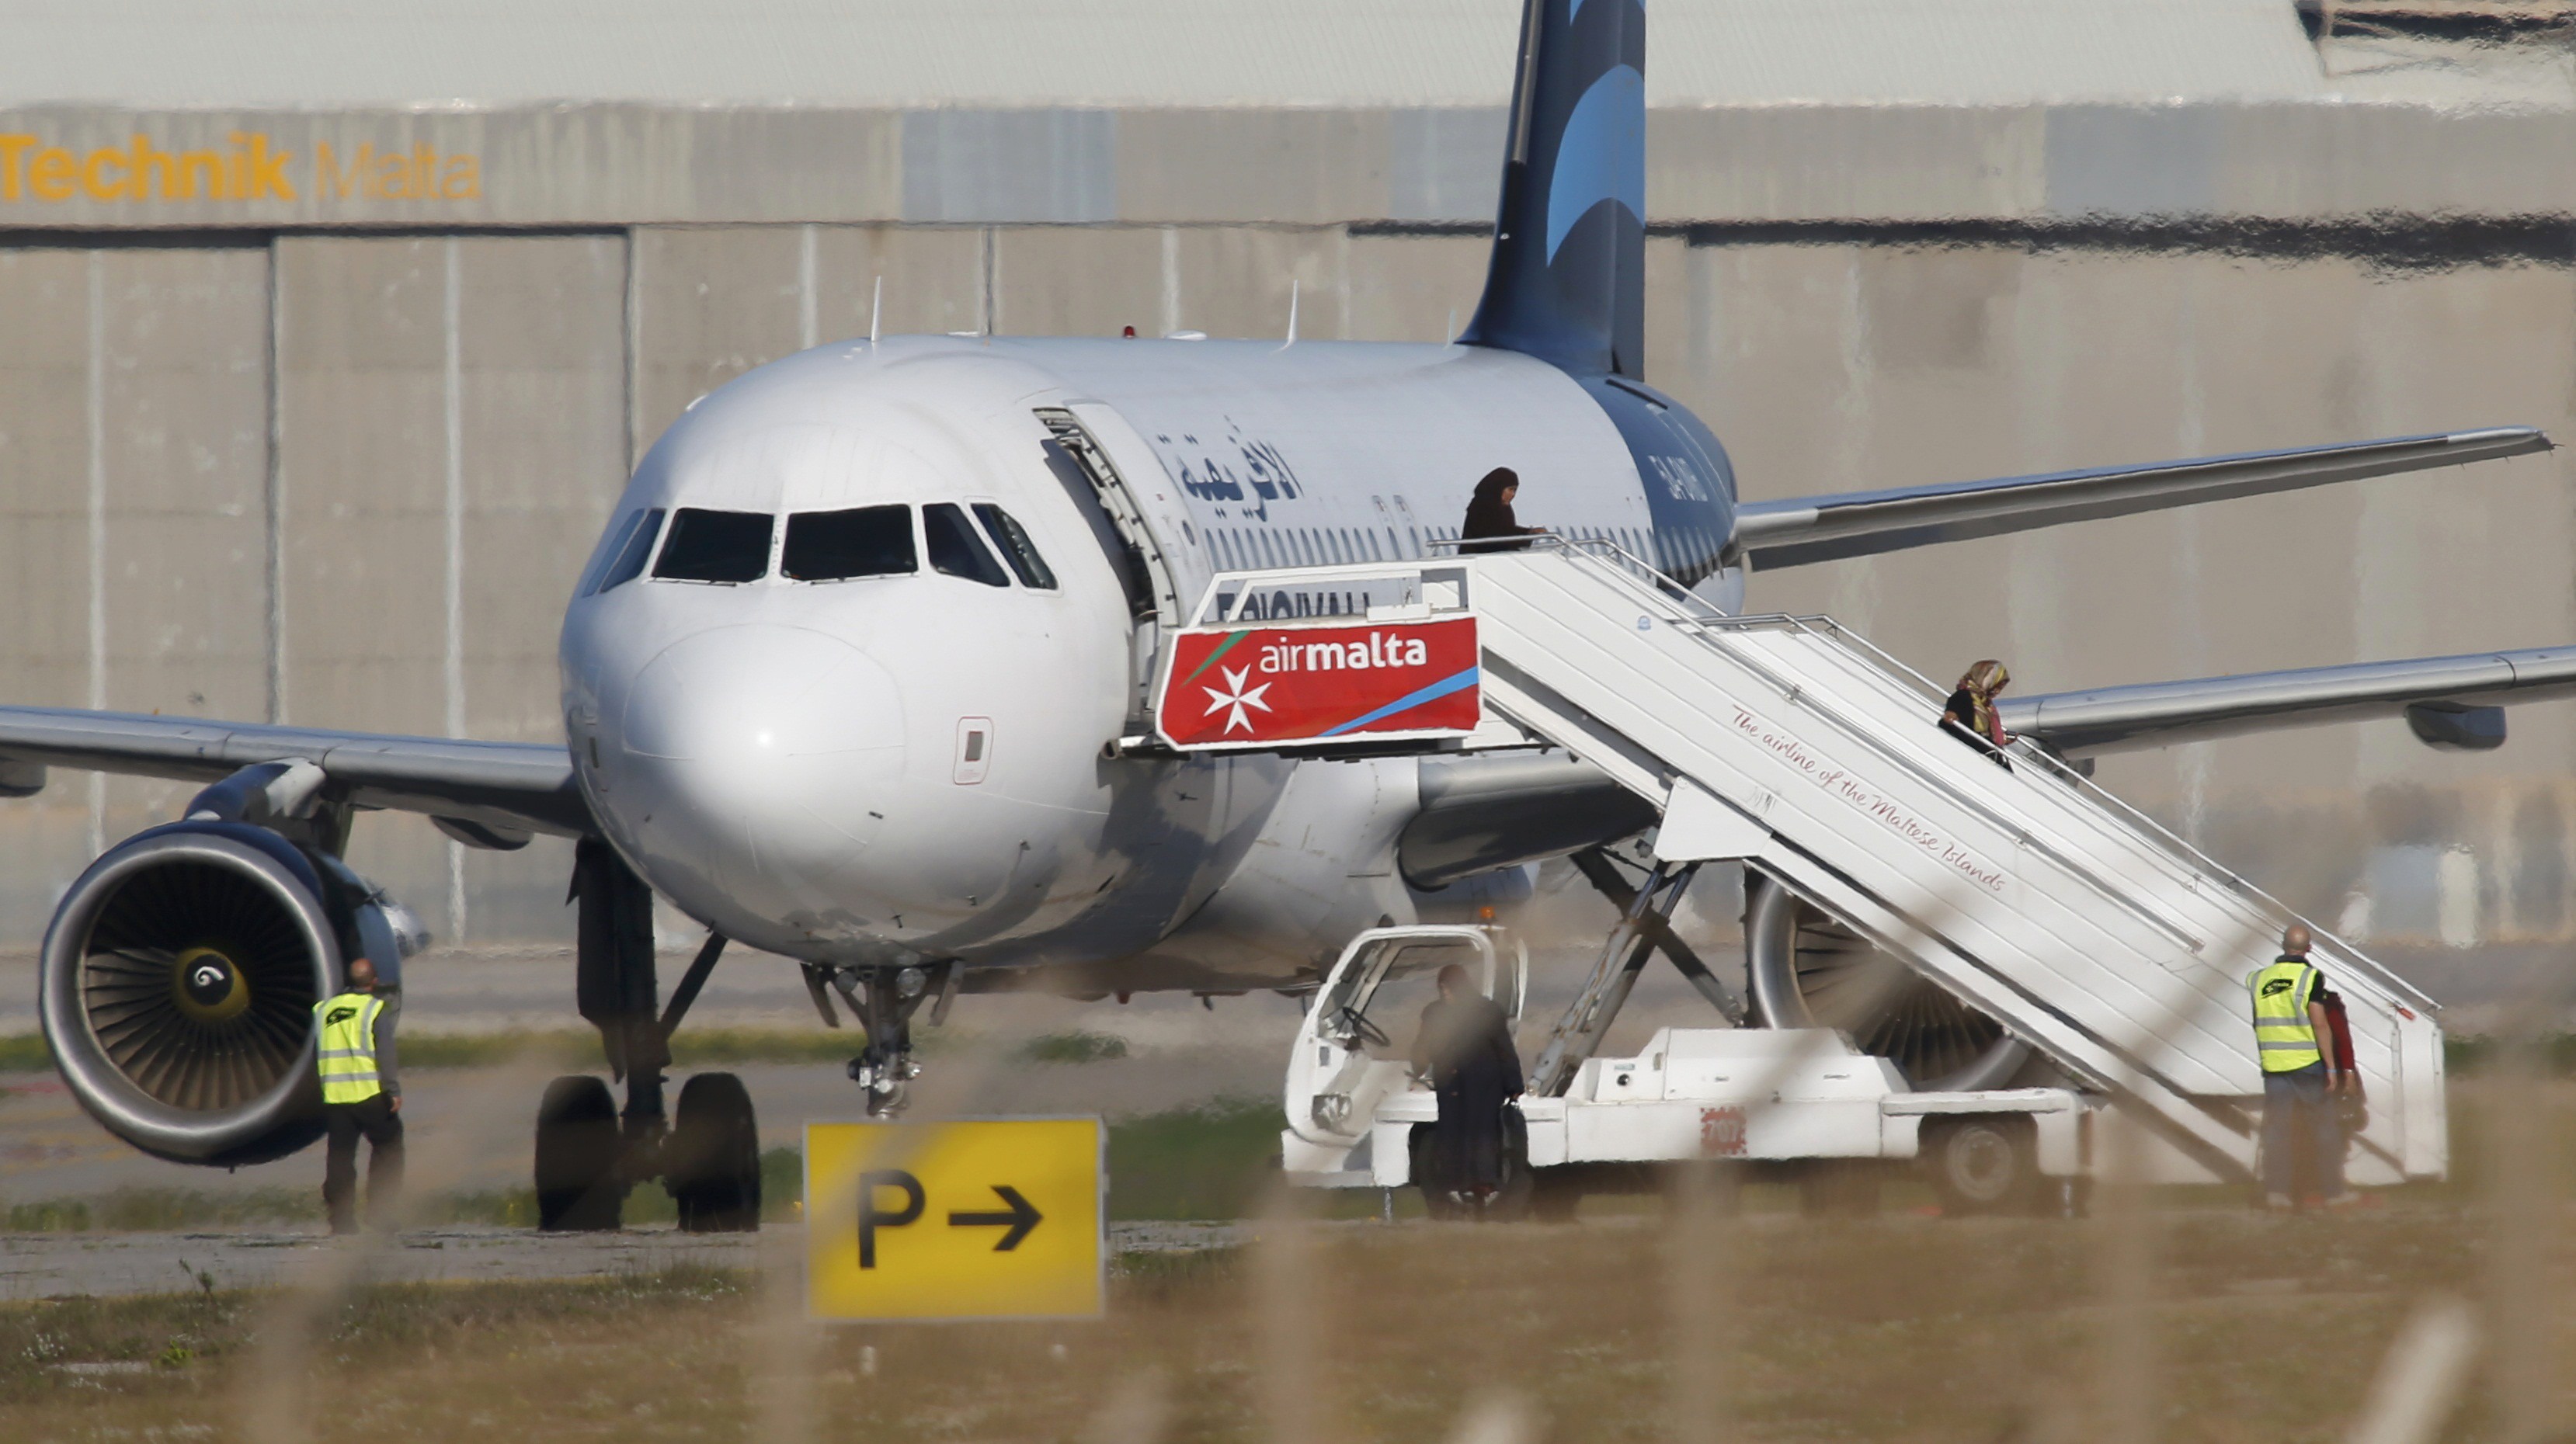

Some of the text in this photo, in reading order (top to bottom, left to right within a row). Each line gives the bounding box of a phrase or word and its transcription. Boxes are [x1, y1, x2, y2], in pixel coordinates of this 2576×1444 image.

[0, 131, 482, 203] Technik Malta
[1259, 631, 1427, 674] airmalta
[1733, 704, 2006, 893] The airline of the Maltese Islands
[858, 1169, 926, 1269] P
